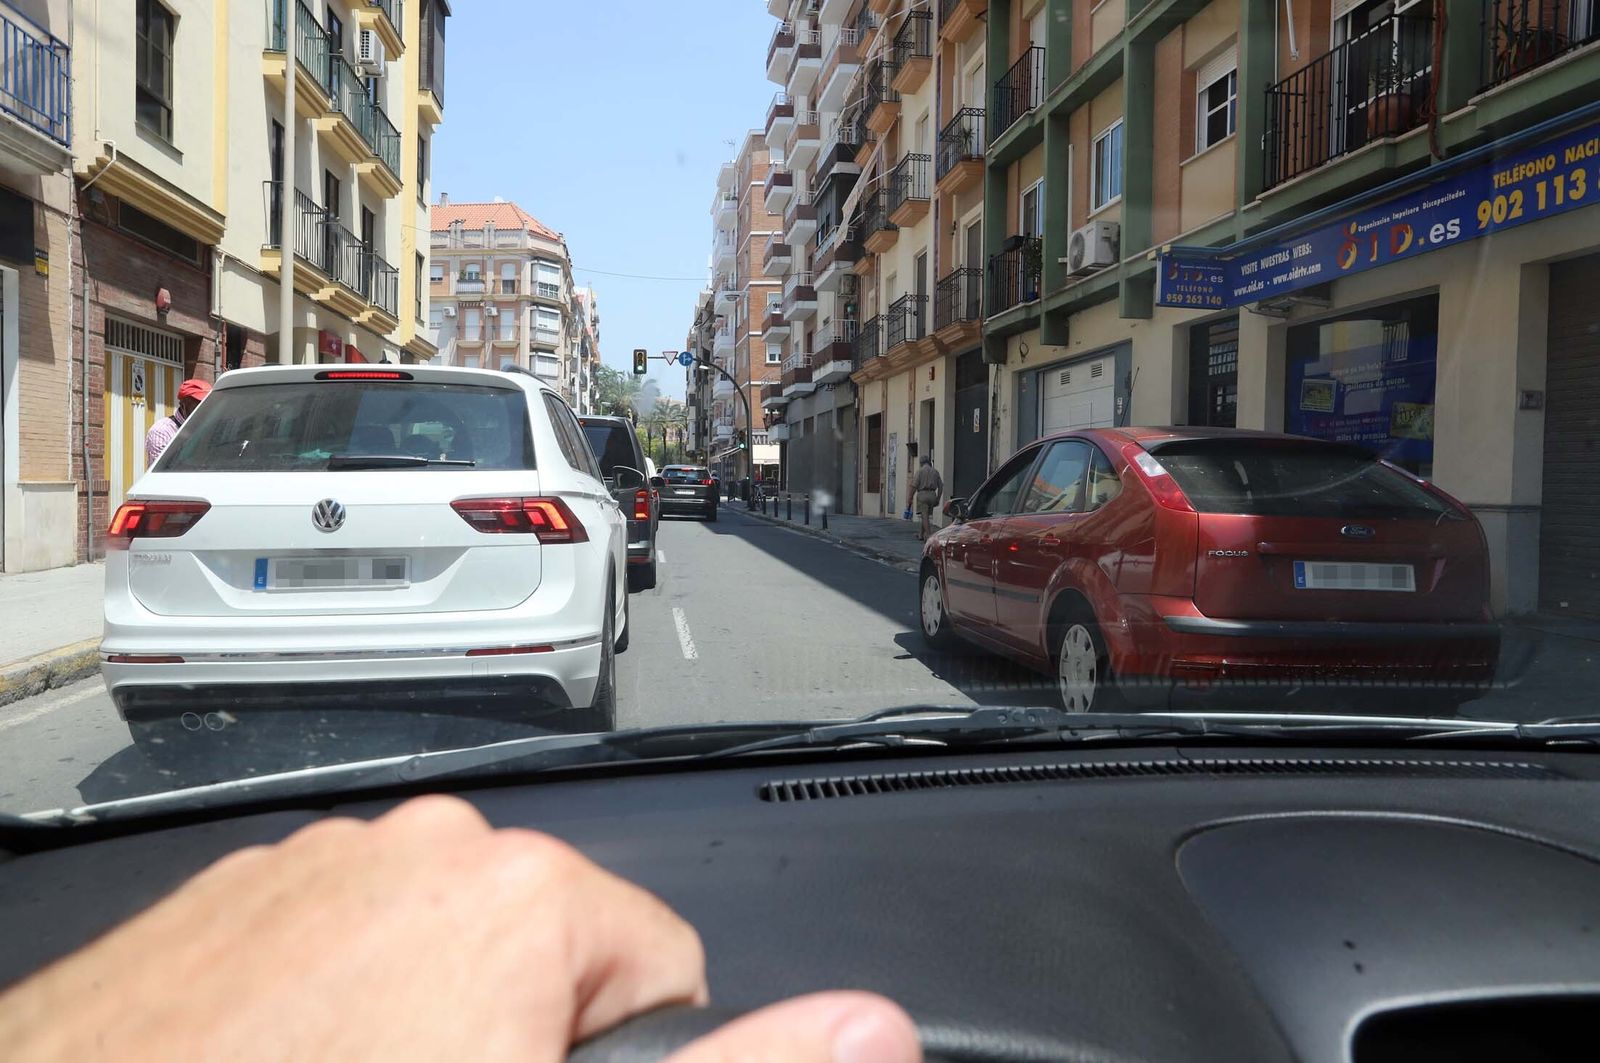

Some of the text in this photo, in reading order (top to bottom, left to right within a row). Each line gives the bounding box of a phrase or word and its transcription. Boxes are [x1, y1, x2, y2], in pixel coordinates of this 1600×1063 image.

[1492, 138, 1600, 190] TELÉFONO NACI
[1477, 168, 1587, 229] 902 113
[1241, 261, 1258, 276] VISITE
[1260, 249, 1290, 270] NUESTRAS
[1292, 242, 1312, 259] WEBS:
[1233, 262, 1322, 297] www.oid.es www.oidrtv.com
[1166, 293, 1222, 305] 959 262 140
[1208, 550, 1248, 558] FOCUS
